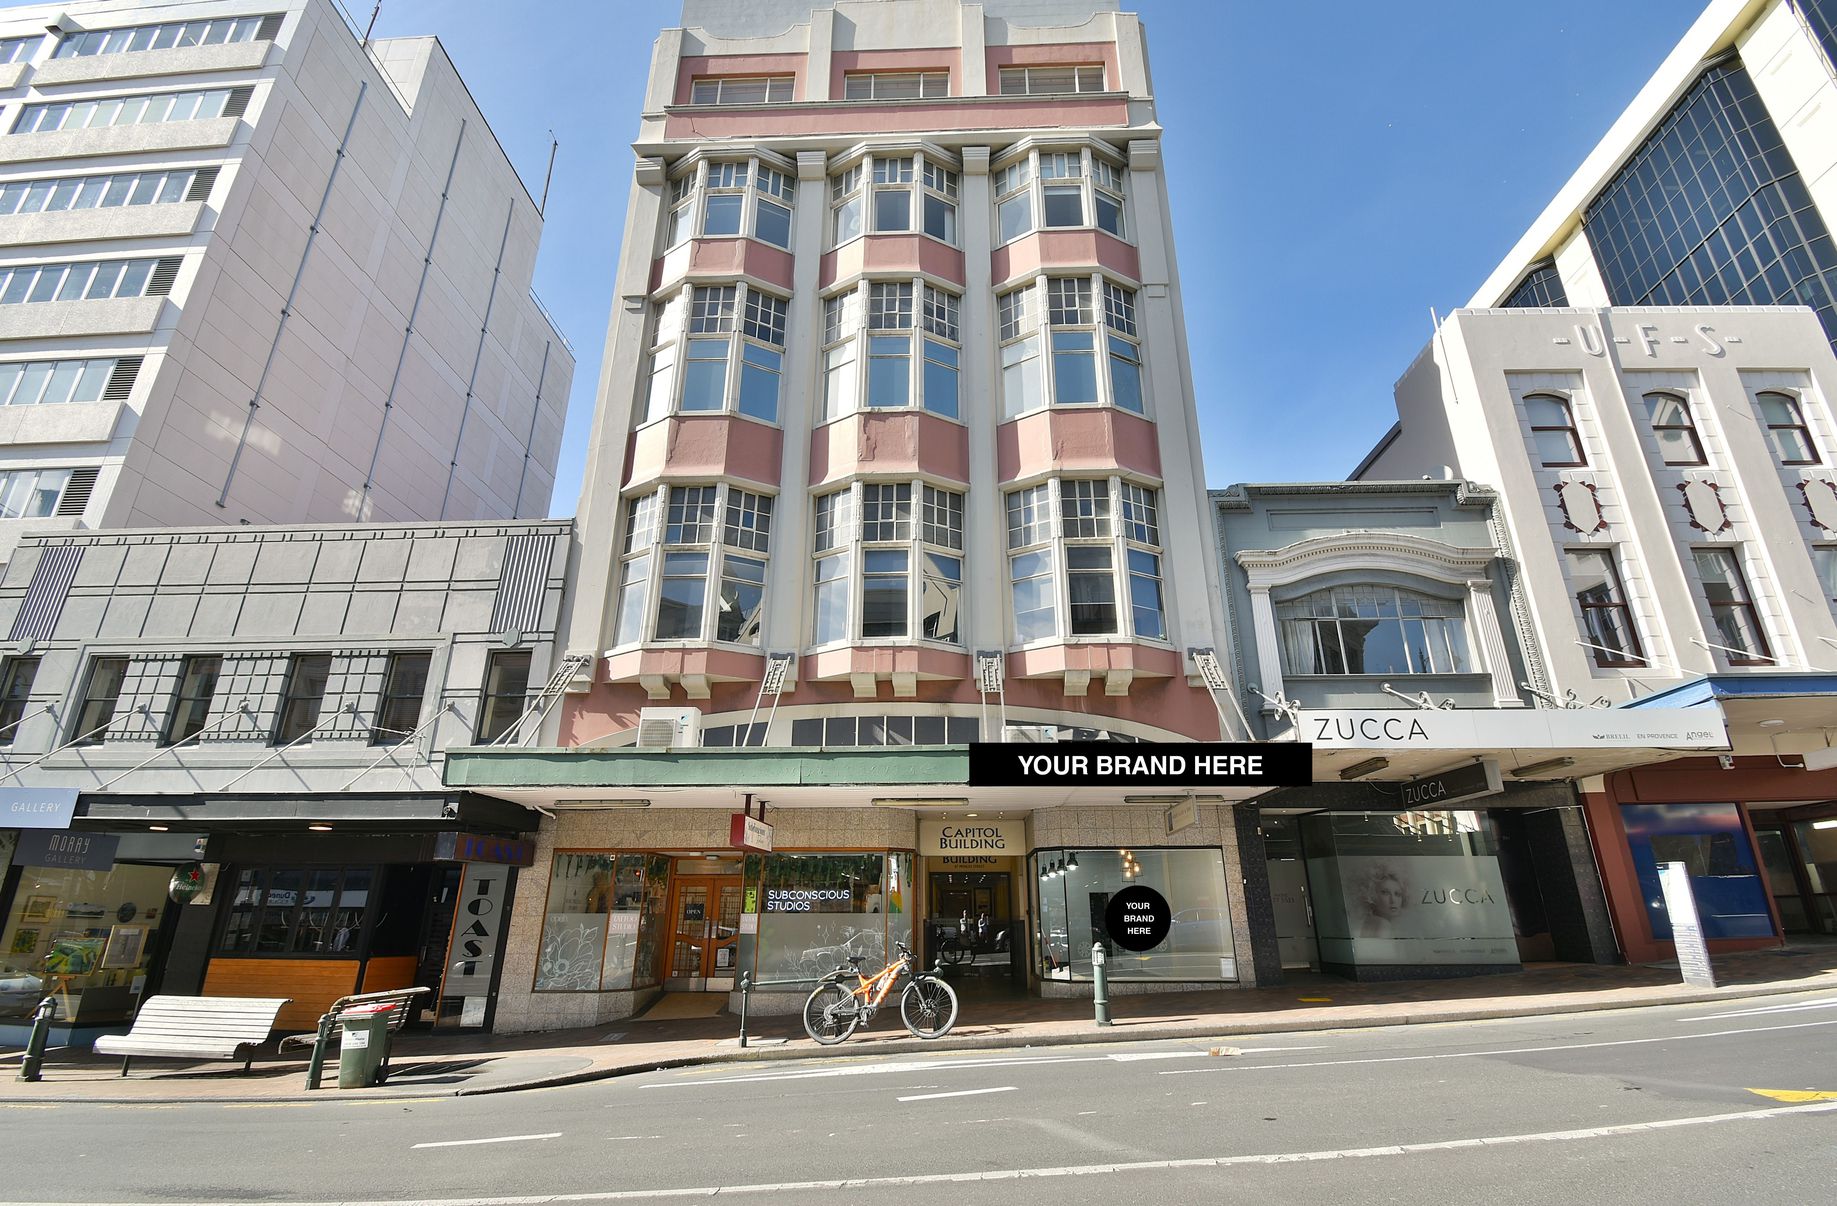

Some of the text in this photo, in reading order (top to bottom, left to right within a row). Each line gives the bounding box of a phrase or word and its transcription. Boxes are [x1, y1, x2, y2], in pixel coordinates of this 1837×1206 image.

[1313, 718, 1429, 740] ZUCCA
[1405, 780, 1447, 804] ZUCCA
[11, 802, 61, 813] GALLERY
[45, 854, 87, 865] GALLERY
[768, 889, 850, 900] SUBCONSCIOUS
[1421, 888, 1495, 904] ZUCCA
[767, 901, 811, 911] STUDIOS
[461, 878, 497, 976] TOAST
